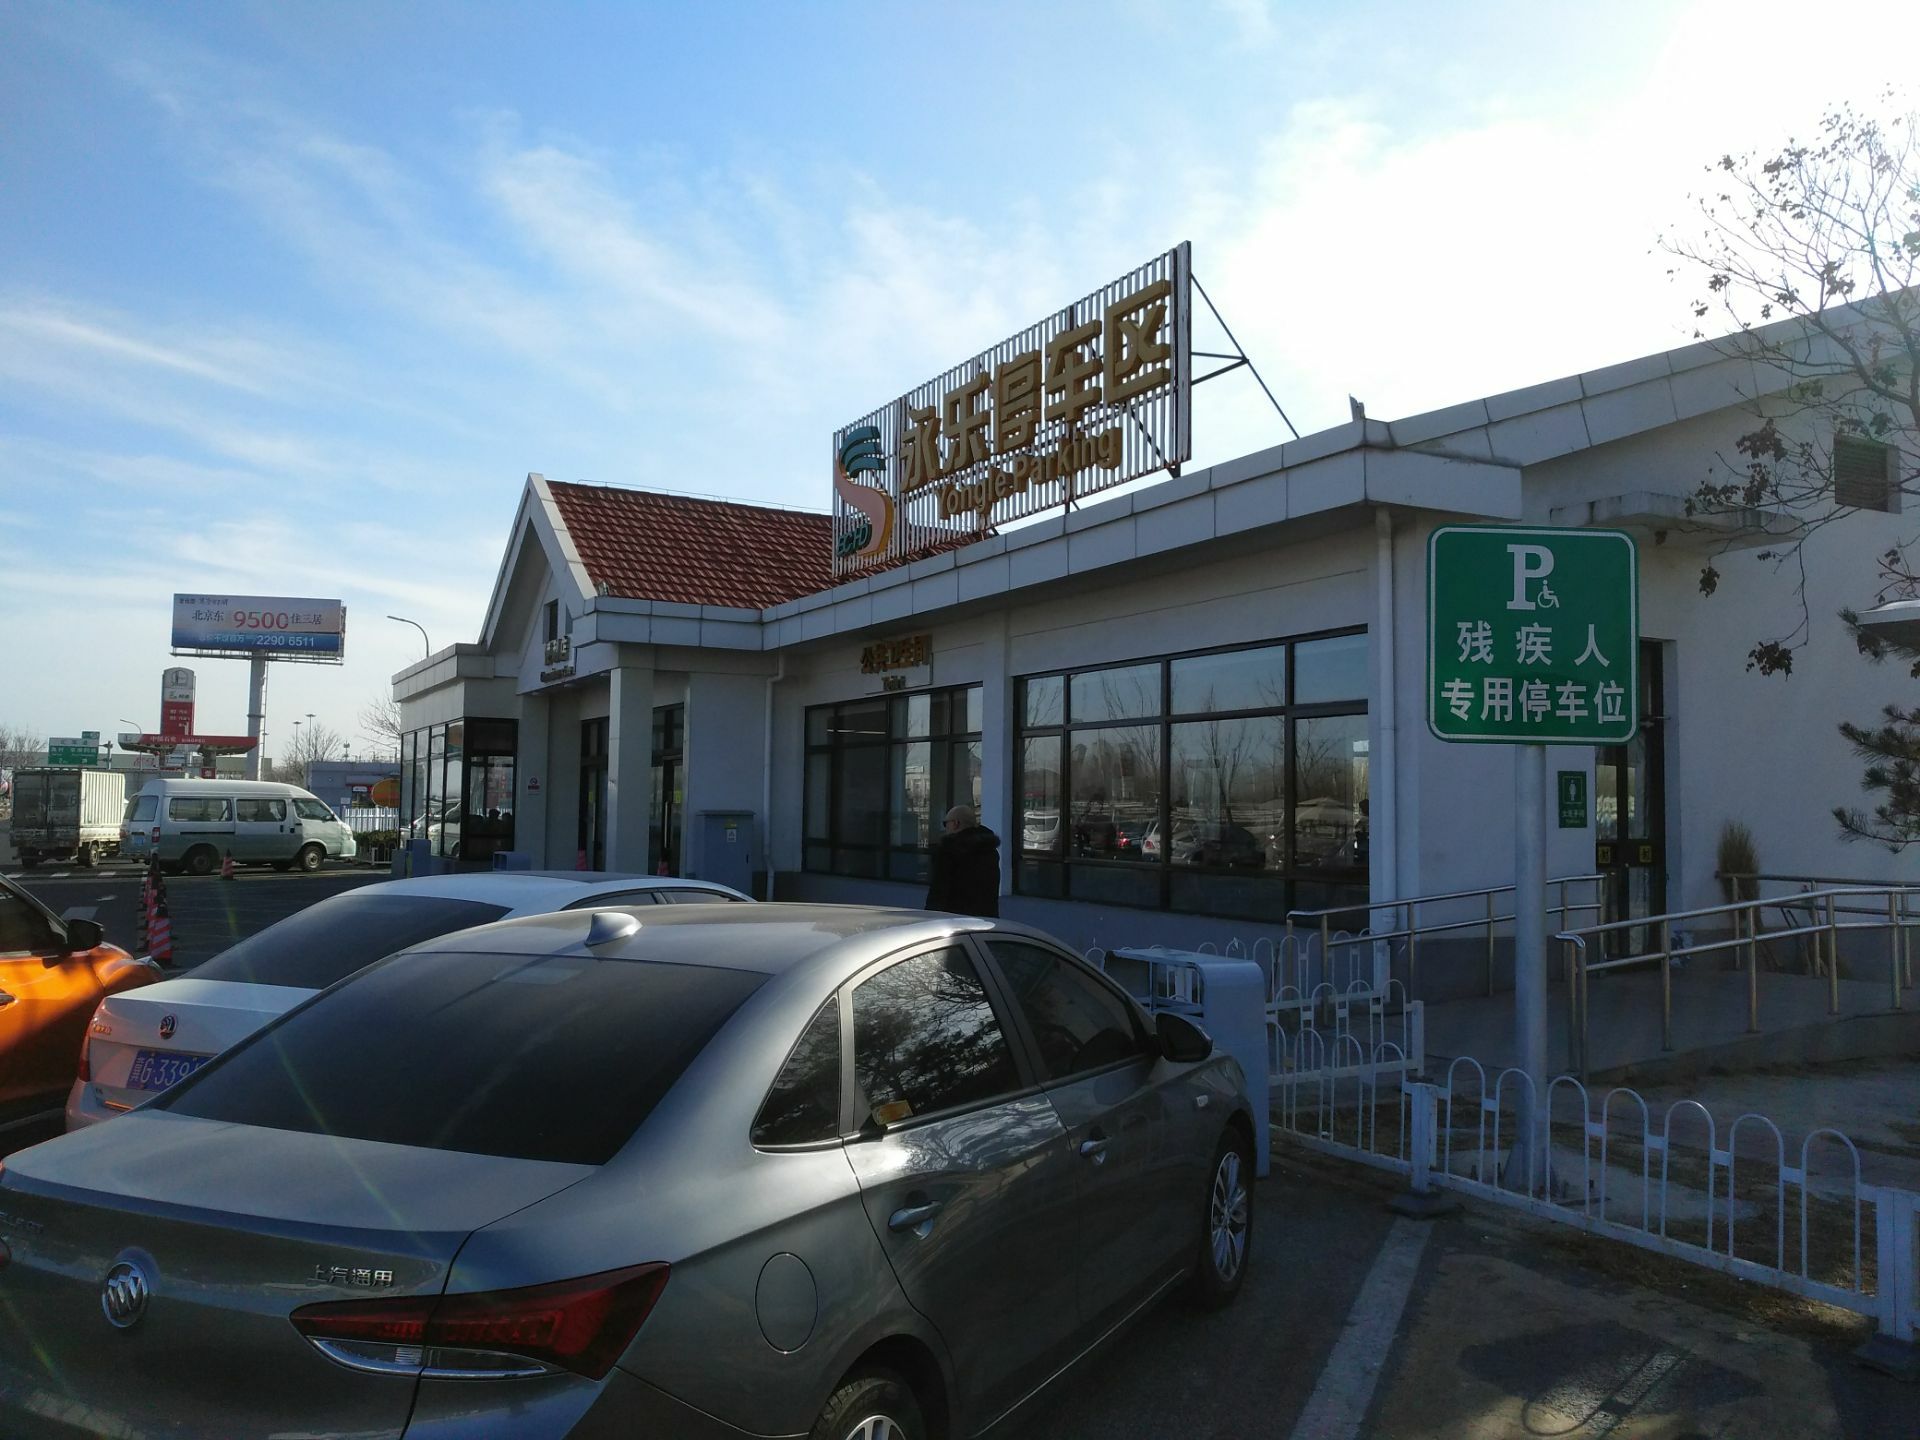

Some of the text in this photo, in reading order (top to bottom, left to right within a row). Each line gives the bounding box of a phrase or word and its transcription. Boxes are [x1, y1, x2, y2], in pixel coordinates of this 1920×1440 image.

[900, 280, 1172, 493] 永乐停车区
[936, 427, 1123, 520] Yongle Parking
[1507, 544, 1555, 611] P
[233, 611, 289, 629] 9500
[257, 634, 285, 646] 2290
[1457, 620, 1610, 668] 残疾人
[1441, 677, 1627, 725] 专用停车位
[307, 1264, 394, 1288] 上汽通用
